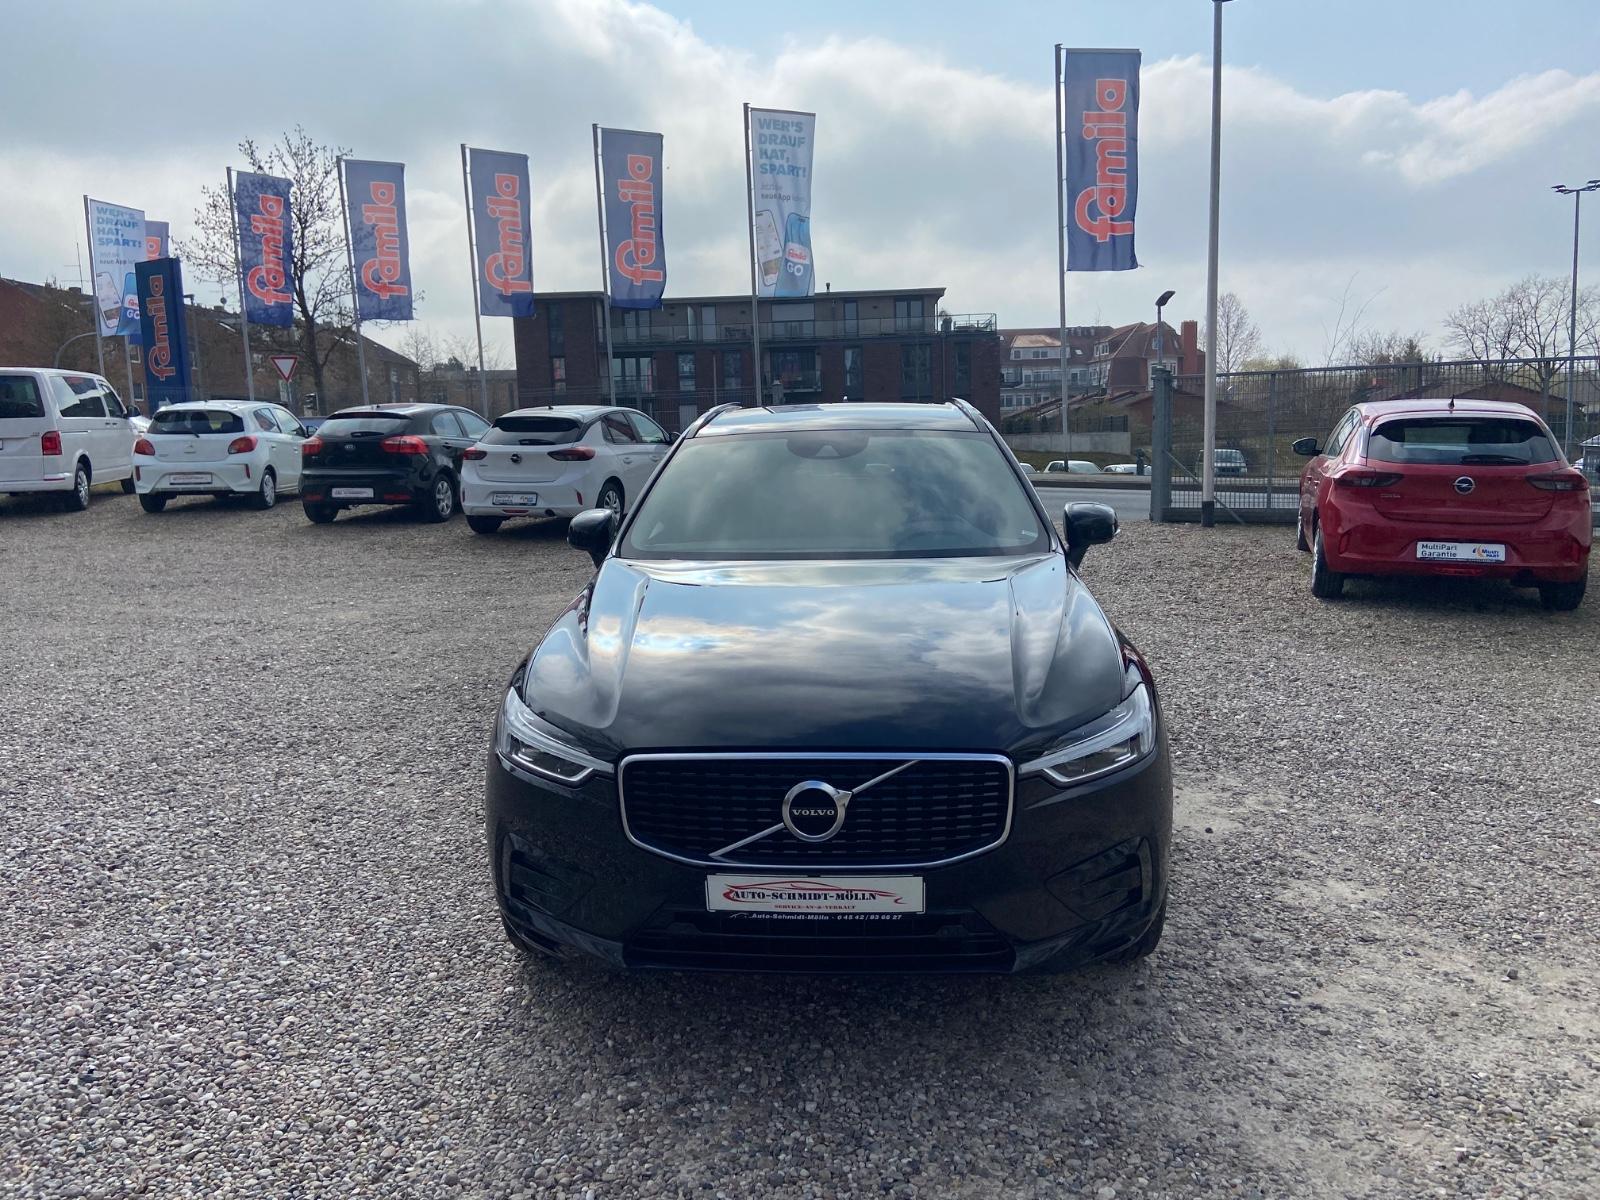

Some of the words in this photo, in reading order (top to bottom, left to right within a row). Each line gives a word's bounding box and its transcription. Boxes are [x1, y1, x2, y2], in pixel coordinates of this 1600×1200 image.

[758, 118, 804, 133] WER'S
[758, 133, 806, 148] DRAUF
[759, 147, 790, 163] HAT,
[1075, 78, 1133, 242] famila
[759, 163, 807, 178] SPART!
[97, 216, 139, 228] DRAUF
[615, 154, 663, 285] famila
[97, 227, 124, 238] HAT,
[485, 173, 531, 296] famila
[98, 237, 142, 248] SPART!
[361, 181, 408, 300] famila
[247, 194, 292, 305] famila
[787, 261, 804, 276] GO
[146, 274, 176, 381] famila
[732, 889, 877, 901] AUTO-SCHMIDT-MÖLLN
